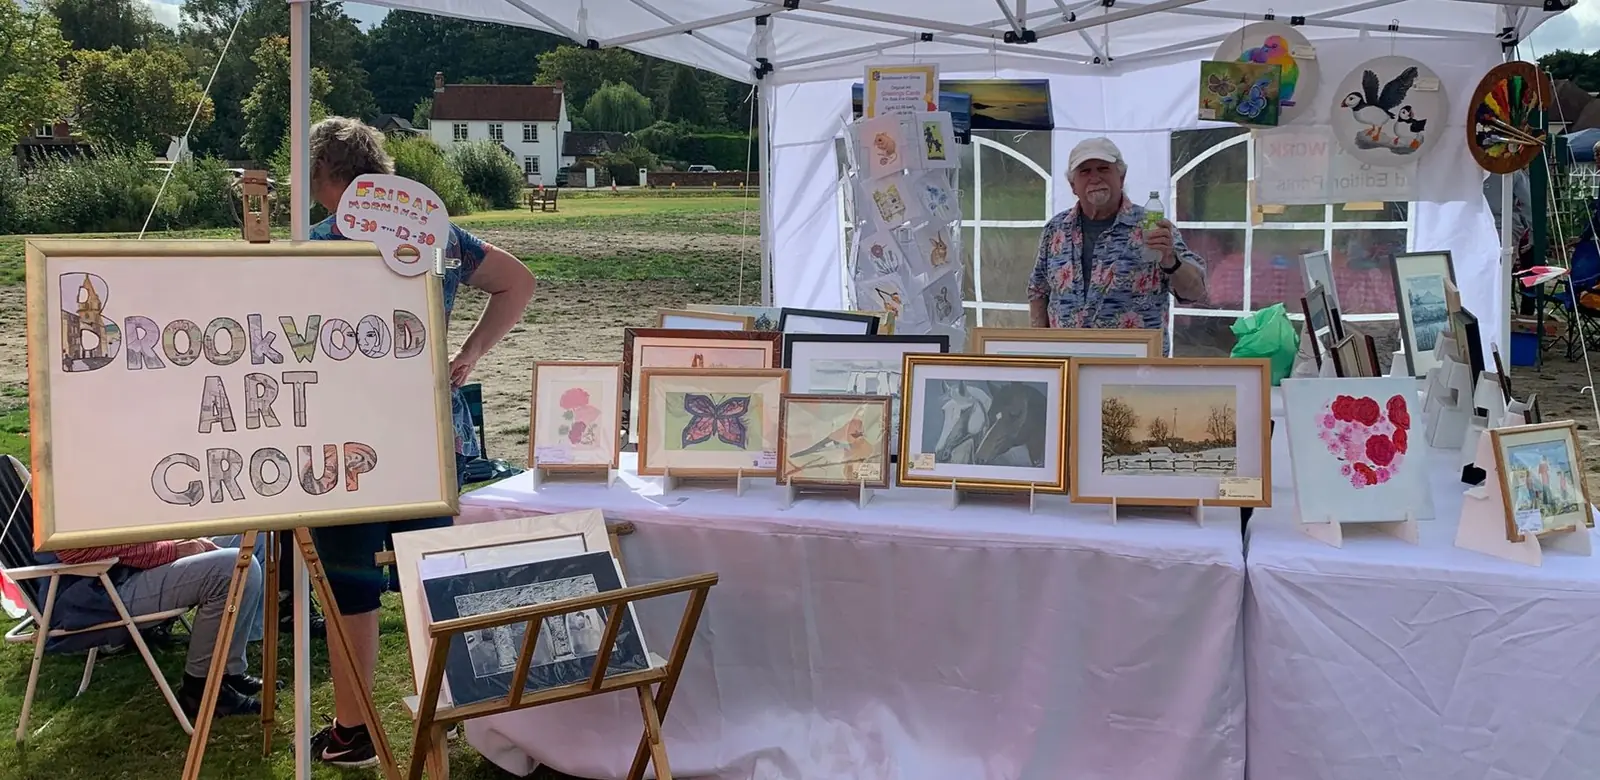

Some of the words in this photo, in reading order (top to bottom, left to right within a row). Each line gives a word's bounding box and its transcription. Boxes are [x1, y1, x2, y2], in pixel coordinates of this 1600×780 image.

[348, 200, 428, 225] MORNINGS
[356, 181, 439, 215] FRIDAY
[197, 370, 319, 434] ART
[150, 441, 378, 507] GROUP
